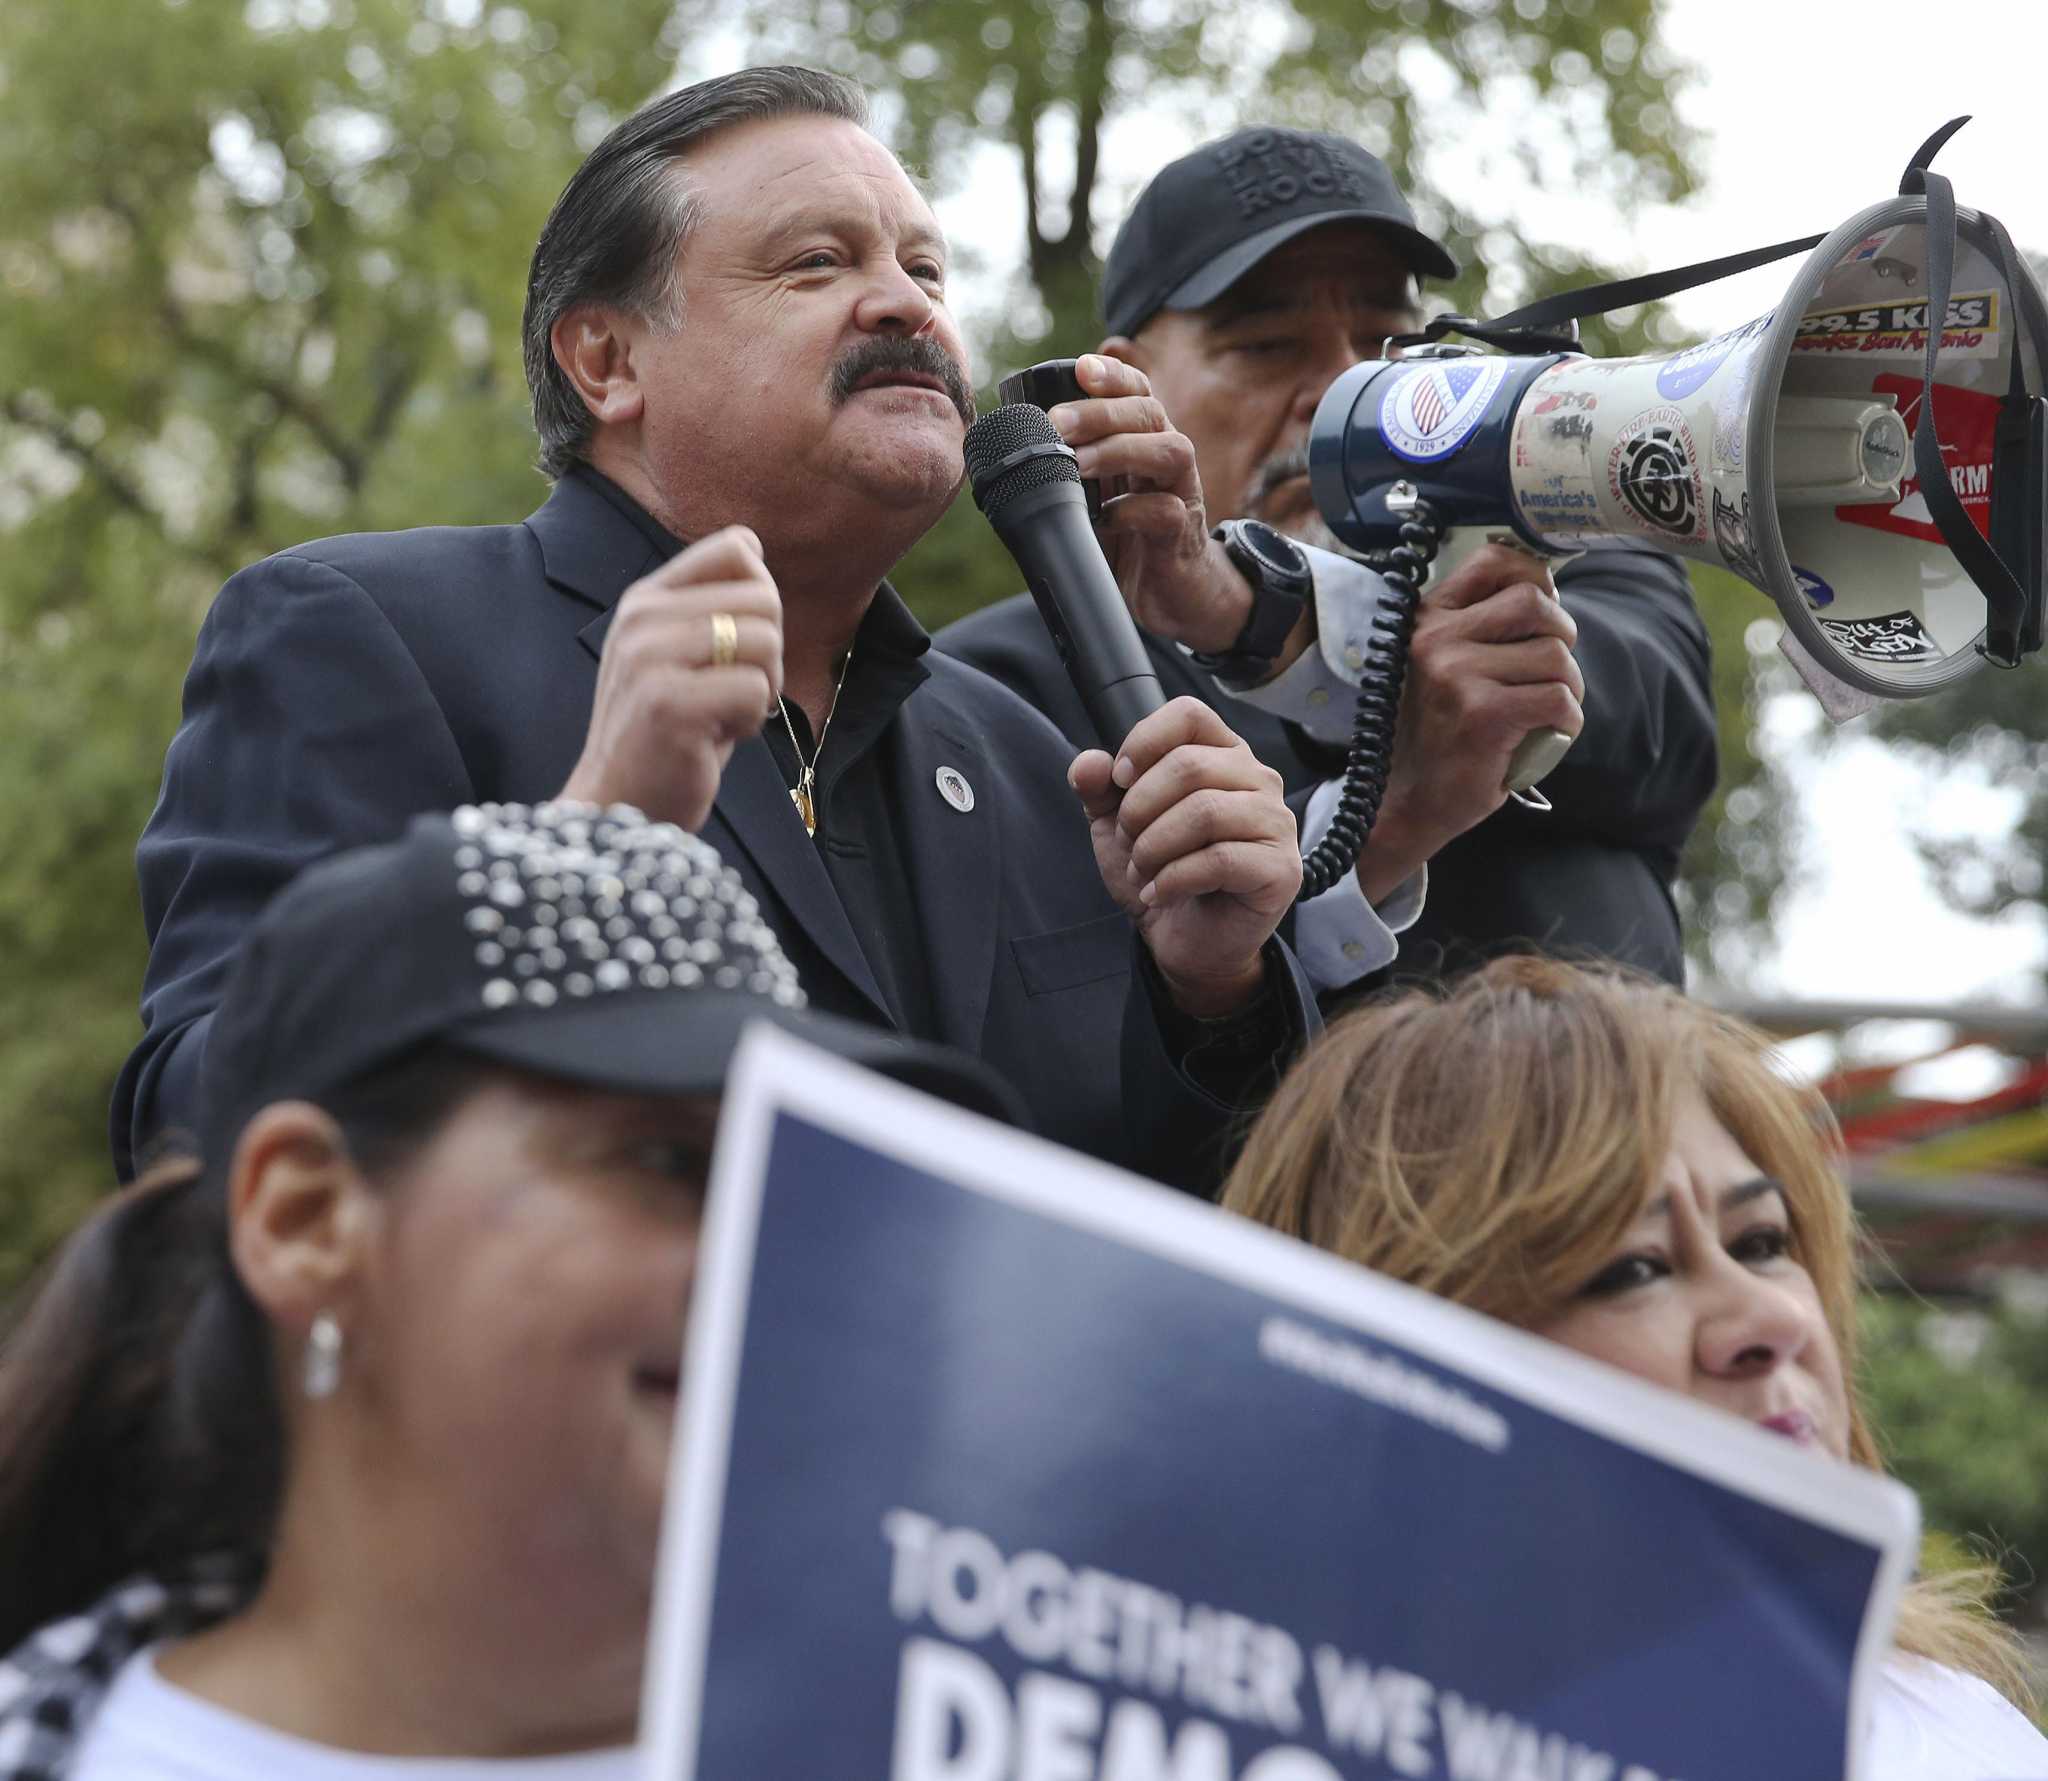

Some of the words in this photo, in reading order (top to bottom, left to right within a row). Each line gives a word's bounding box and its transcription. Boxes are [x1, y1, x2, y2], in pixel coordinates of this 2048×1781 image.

[1801, 310, 1880, 333] 99.5
[1903, 328, 1984, 351] Anonio
[1414, 440, 1436, 453] 1929
[1520, 489, 1597, 508] America's
[882, 1507, 1304, 1735] TOGETHER
[1312, 1643, 1435, 1778] WE
[891, 1636, 1346, 1781] DEM
